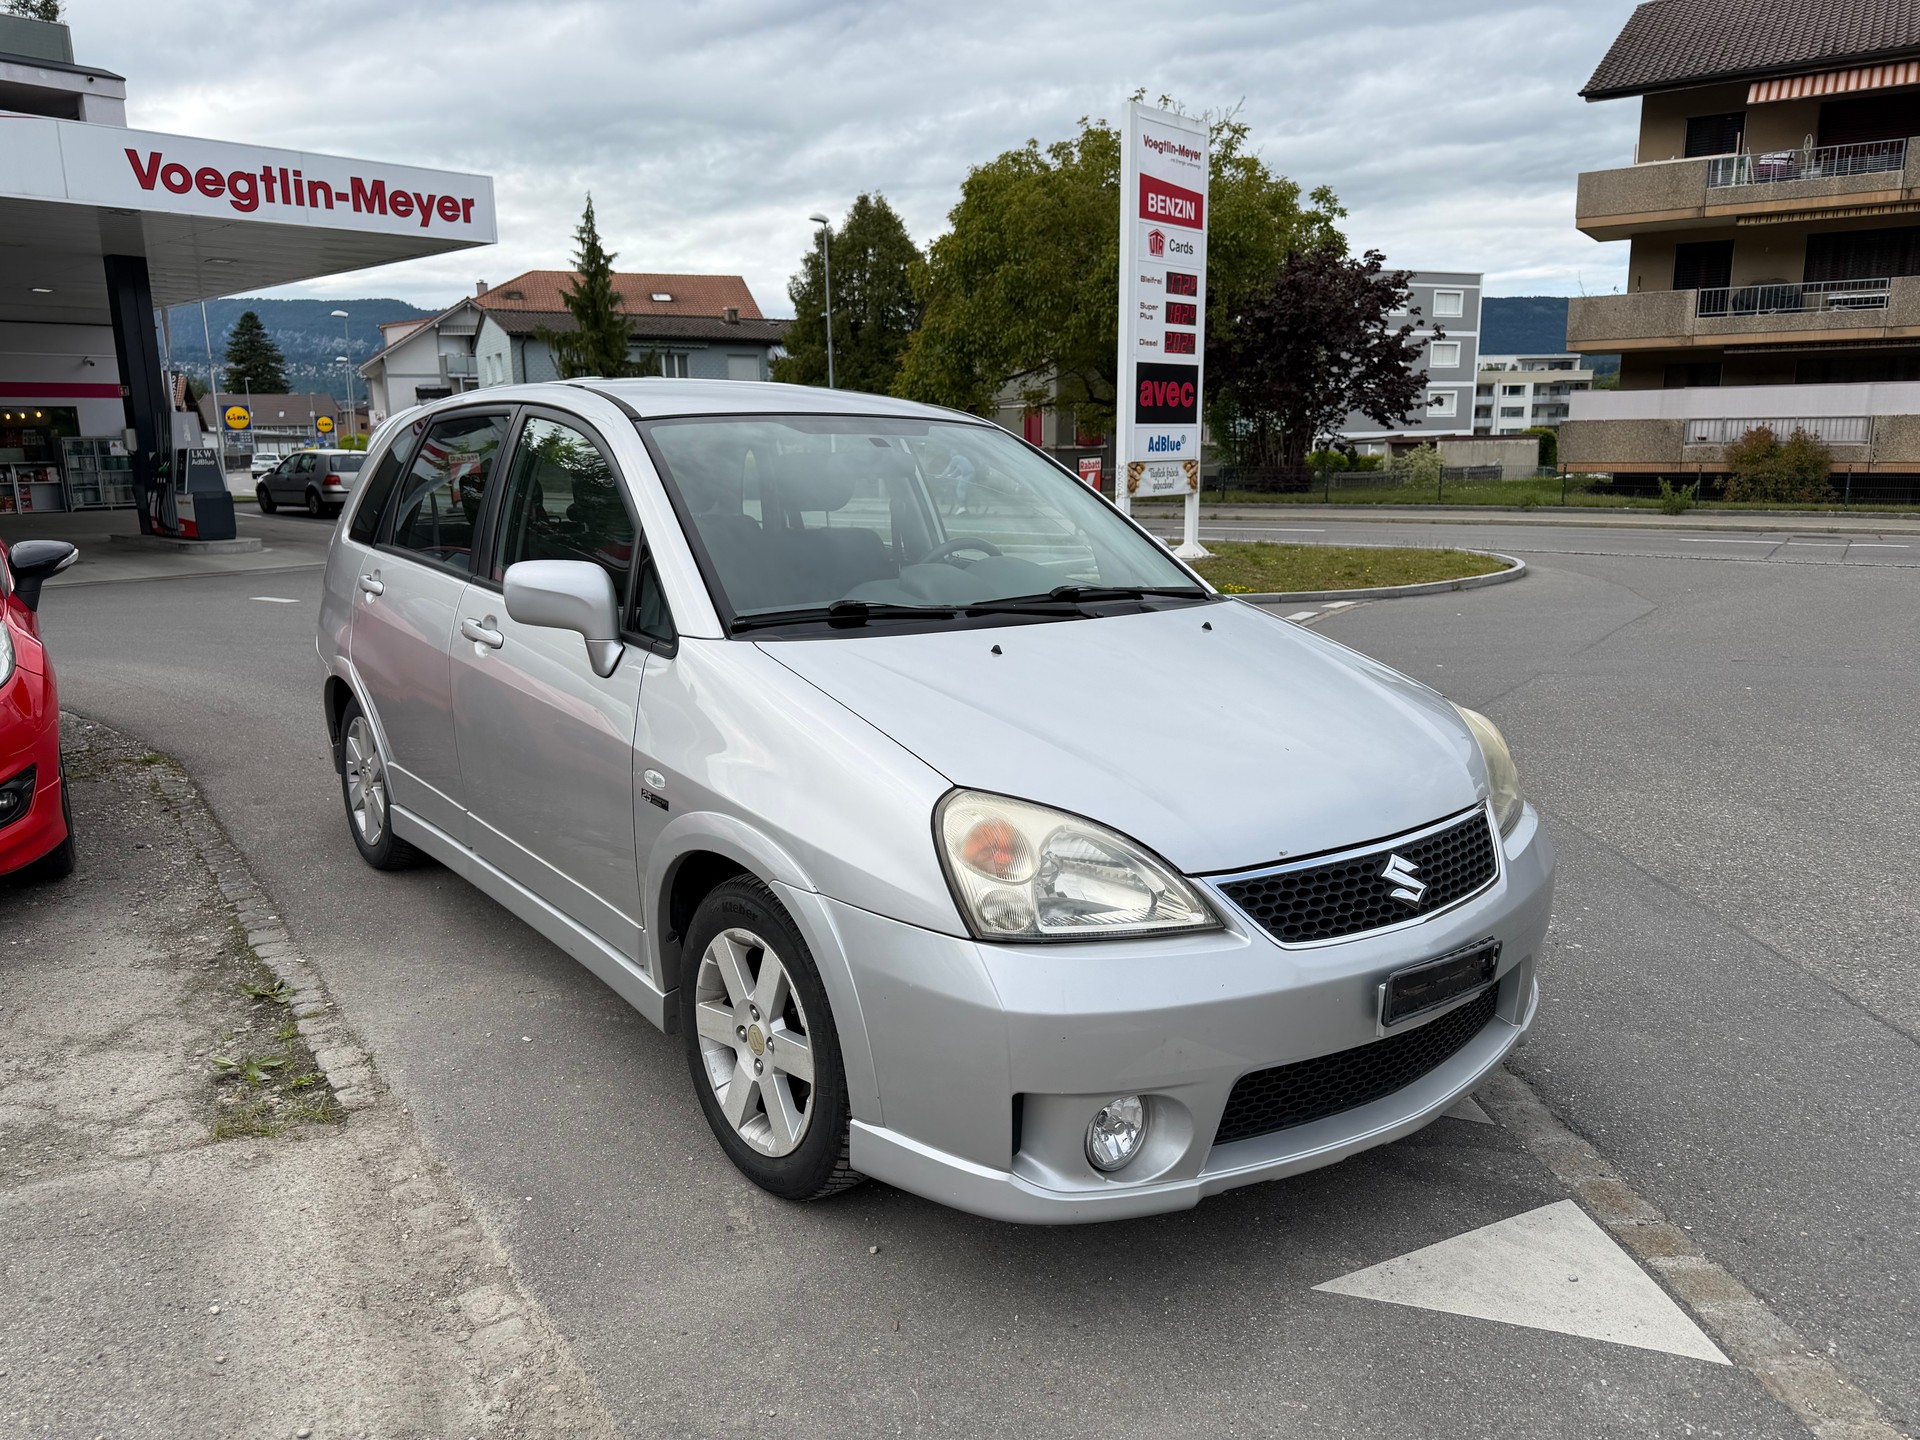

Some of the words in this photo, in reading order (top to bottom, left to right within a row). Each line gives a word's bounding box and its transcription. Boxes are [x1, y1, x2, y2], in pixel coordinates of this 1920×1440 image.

[1143, 134, 1201, 161] Voegtlin-Meyer
[124, 148, 475, 228] Voegtlin-Meyer
[1147, 192, 1196, 221] BENZIN
[1169, 238, 1194, 255] Cards
[1140, 275, 1162, 285] Bleifrei
[1140, 302, 1159, 312] Super
[1140, 312, 1153, 320] Plus
[1139, 338, 1158, 347] Diesel
[1140, 380, 1195, 408] avec
[191, 450, 212, 458] LKW
[1080, 460, 1100, 470] Rabatt
[721, 901, 758, 921] Kleber
